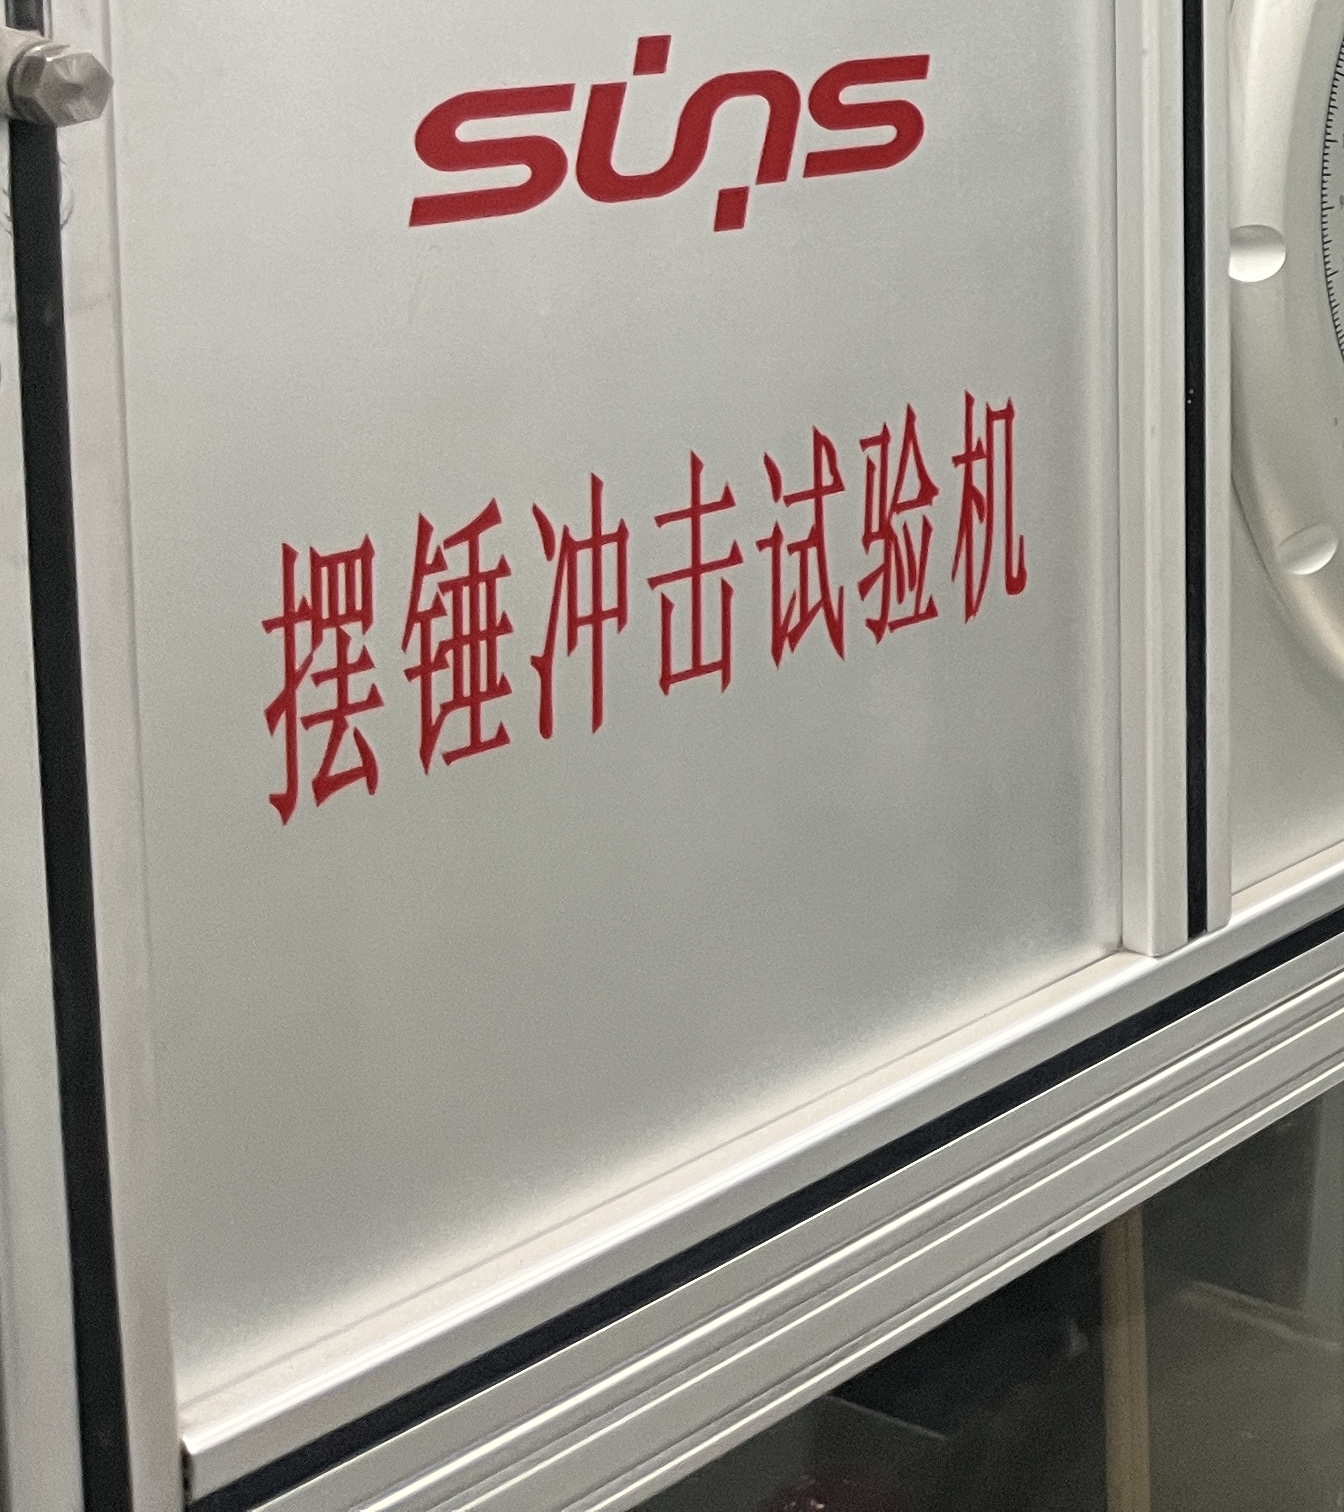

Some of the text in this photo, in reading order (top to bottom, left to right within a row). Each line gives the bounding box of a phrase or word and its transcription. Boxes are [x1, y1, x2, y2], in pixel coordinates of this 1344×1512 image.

[261, 390, 1027, 826] 摆锤冲击试验机
